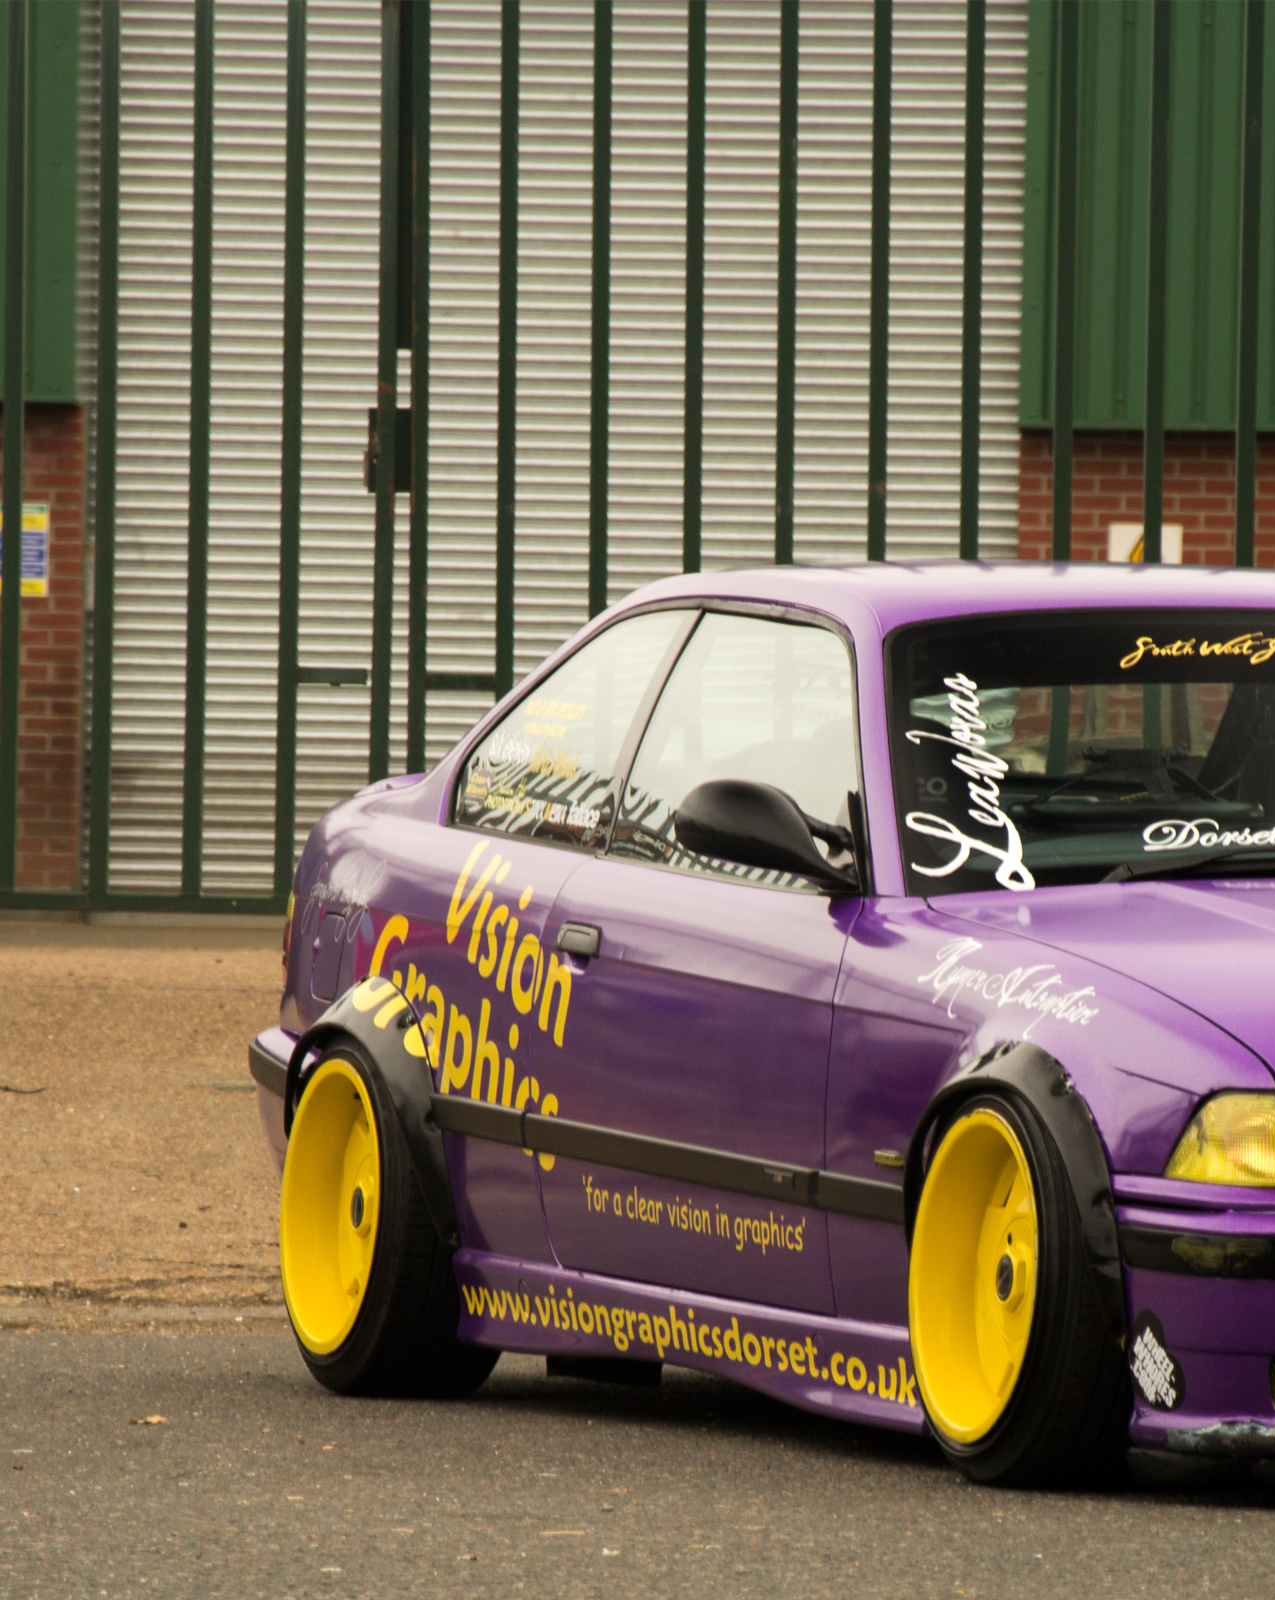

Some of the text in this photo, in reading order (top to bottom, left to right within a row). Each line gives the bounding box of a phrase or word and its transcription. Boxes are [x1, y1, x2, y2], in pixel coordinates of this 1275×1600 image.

[1120, 635, 1196, 668] South
[1199, 631, 1264, 657] West
[446, 839, 572, 1048] Vision
[352, 914, 561, 1172] Graphics
[613, 1192, 623, 1216] a
[626, 1185, 663, 1225] clear
[667, 1196, 711, 1236] vision
[715, 1203, 730, 1239] in
[461, 1283, 917, 1408] www.visiongraphicsdorset.co.uk
